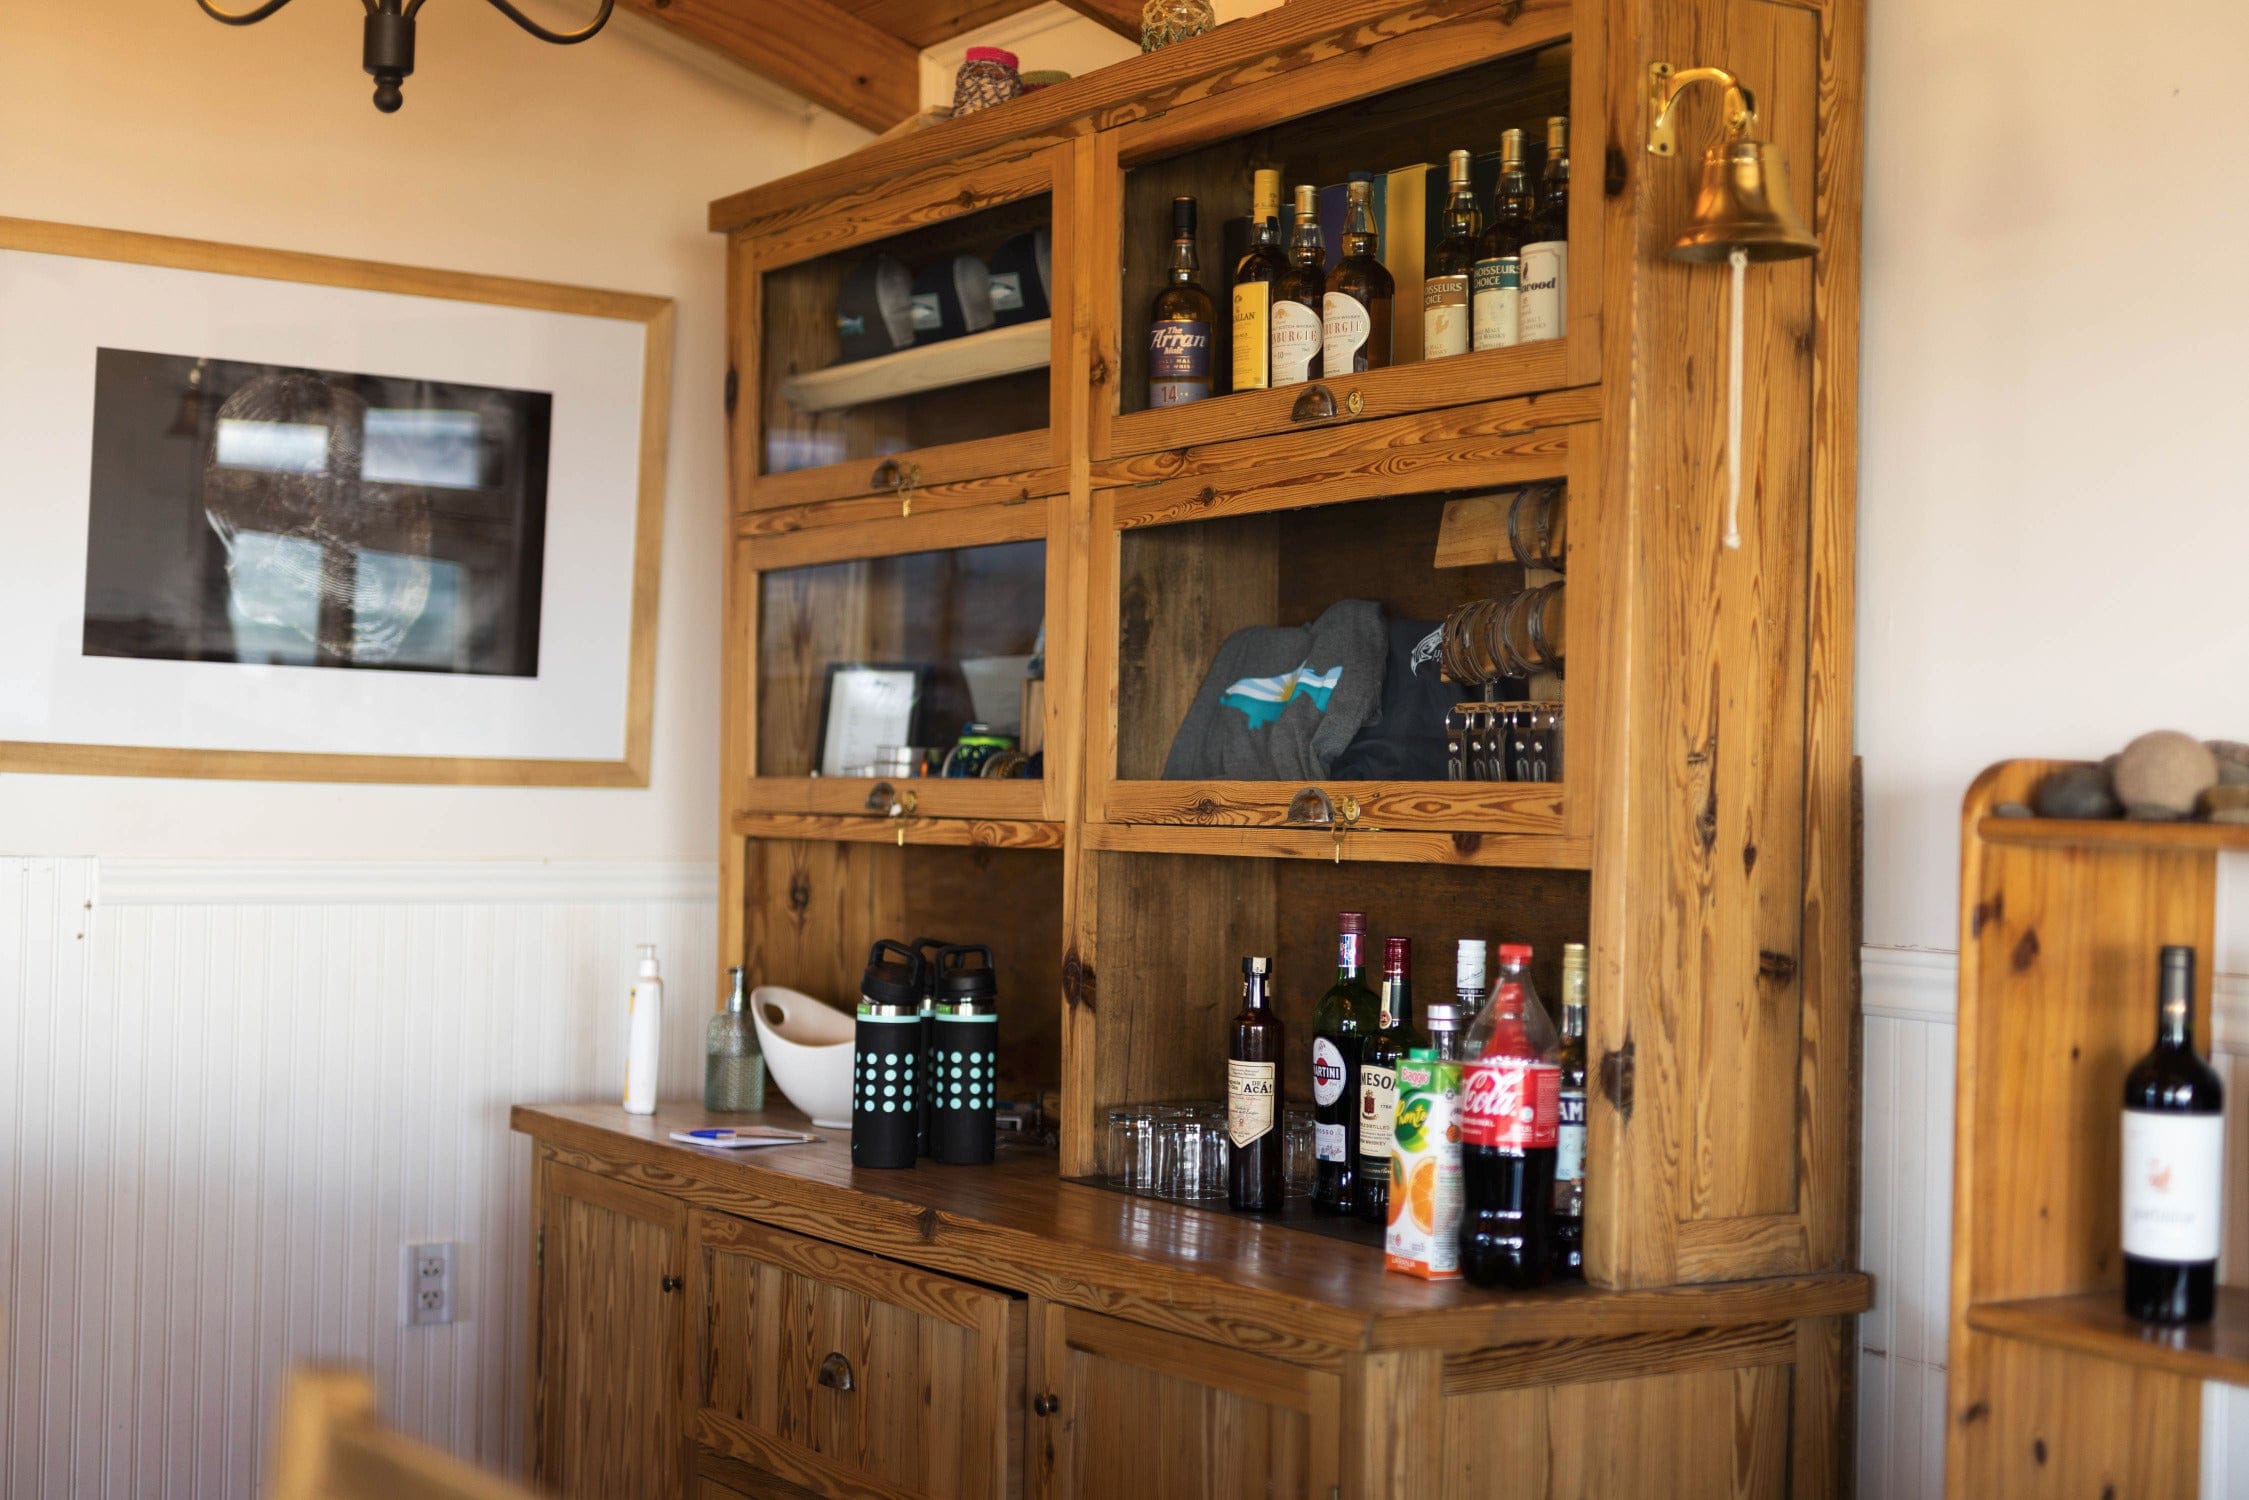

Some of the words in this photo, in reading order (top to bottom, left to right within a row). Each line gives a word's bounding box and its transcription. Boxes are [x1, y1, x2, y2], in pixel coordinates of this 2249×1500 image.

[1425, 294, 1442, 305] OICE
[1167, 326, 1183, 334] The
[1150, 329, 1206, 350] Arran
[1161, 384, 1179, 402] 14
